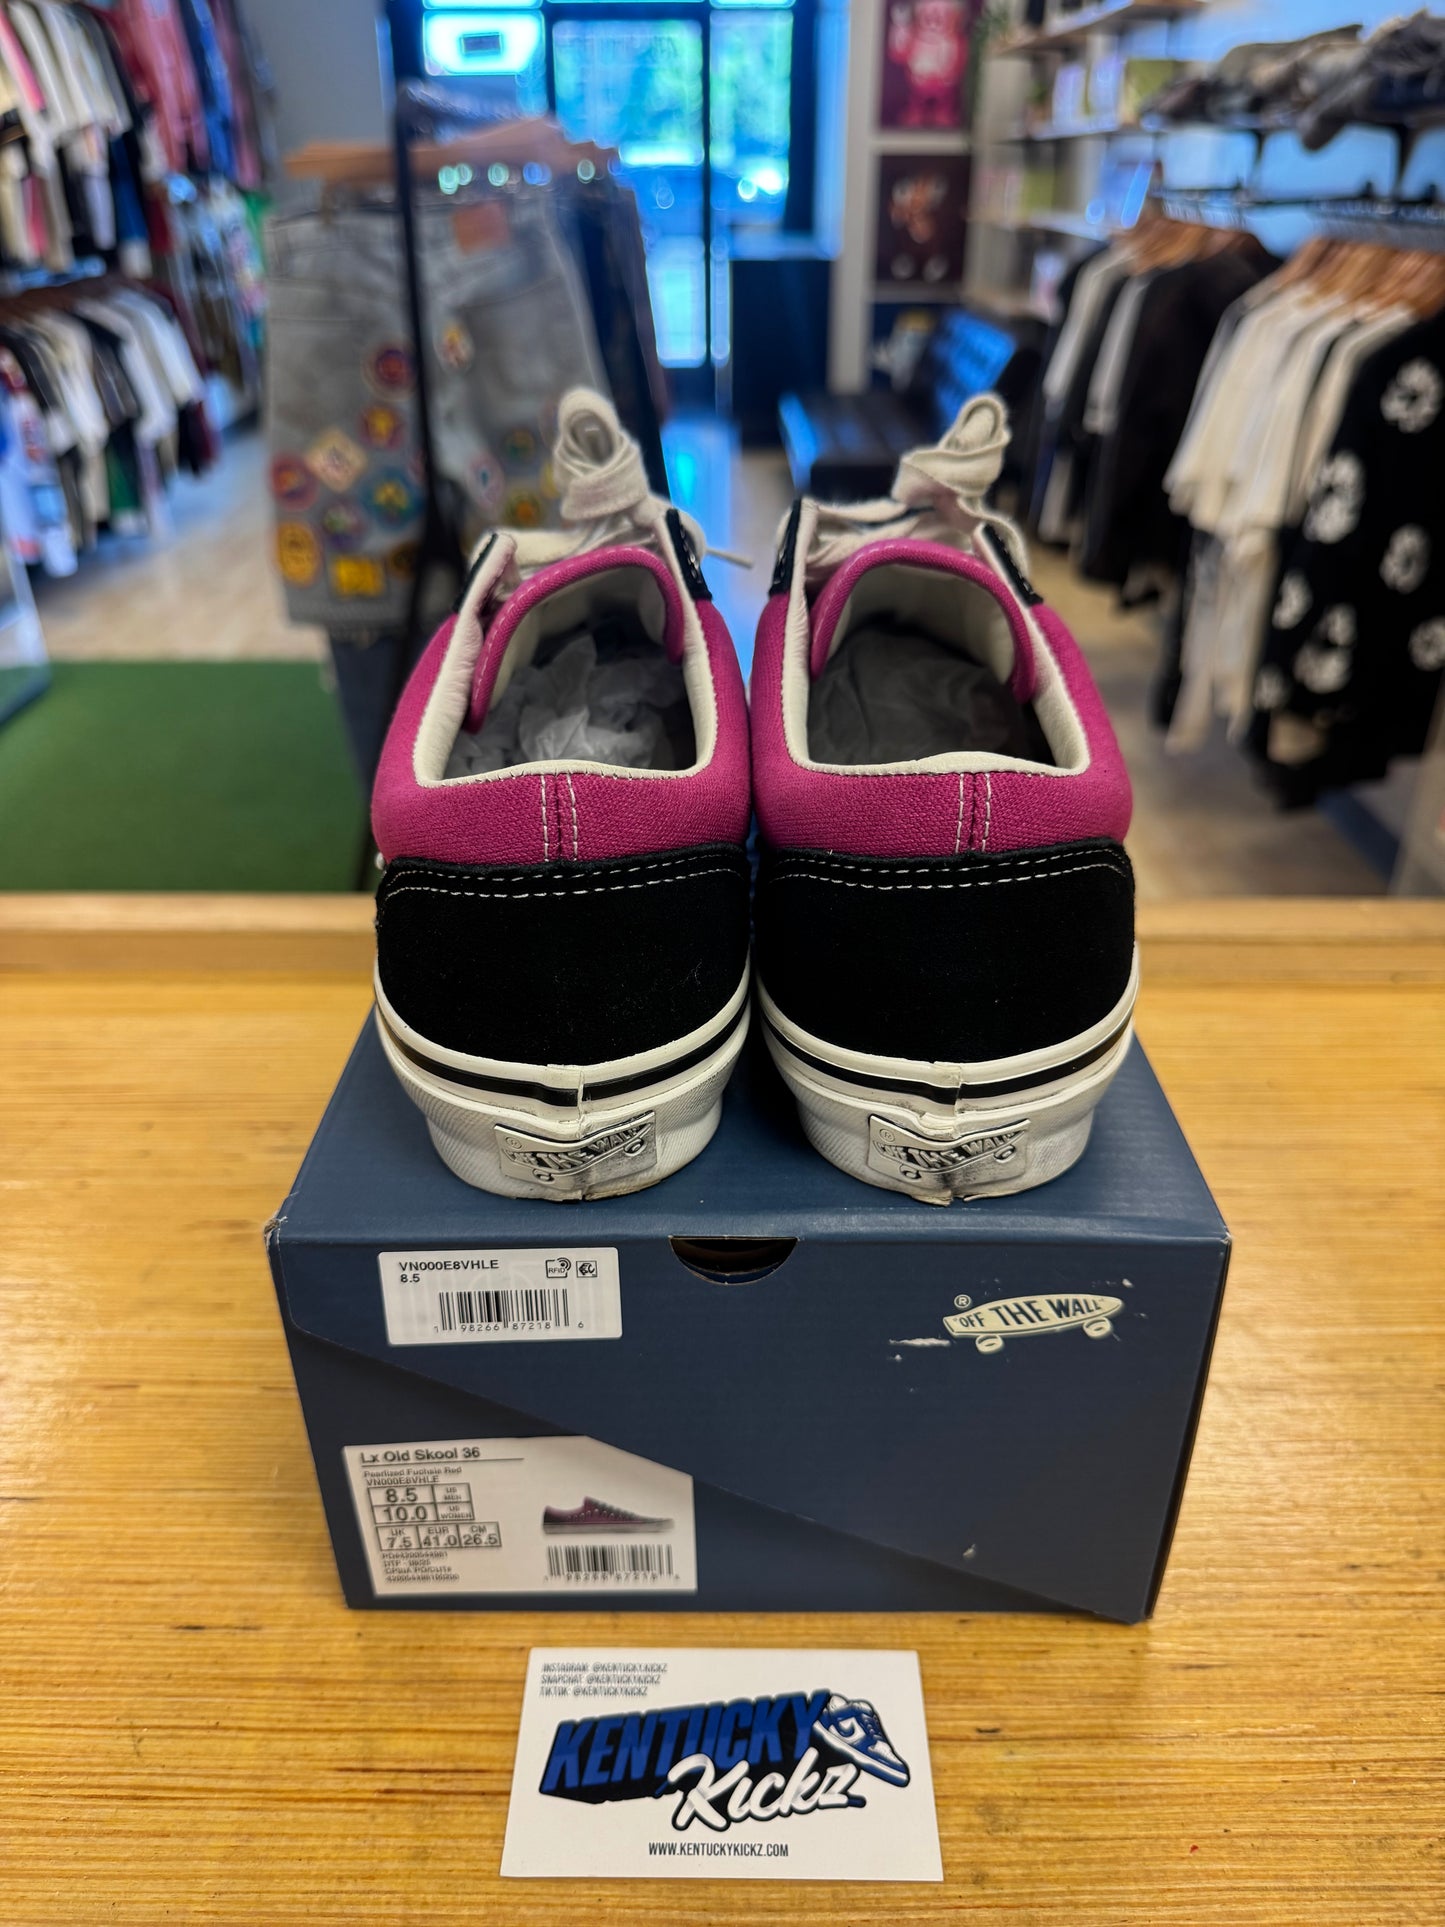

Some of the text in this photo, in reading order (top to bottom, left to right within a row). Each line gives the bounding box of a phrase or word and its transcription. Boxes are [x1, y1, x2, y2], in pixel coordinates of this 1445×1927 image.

[399, 1259, 500, 1272] VN000E8VHLE
[400, 1273, 421, 1283] 8.5
[989, 1300, 1050, 1326] THE
[361, 1447, 480, 1463] Lx Old Skool 36
[386, 1487, 418, 1503] 8.5
[383, 1505, 428, 1521] 10.0
[391, 1528, 406, 1536] UK
[427, 1526, 450, 1535] EUR
[470, 1525, 487, 1533] CM
[387, 1537, 413, 1548] 7.5
[422, 1535, 458, 1547] 41.0
[463, 1533, 498, 1545] 26.5
[541, 1692, 829, 1794] KENTUCKY
[667, 1747, 858, 1831] Kickz
[648, 1842, 789, 1857] WWW.KENTUCKYKICKZ.COM
